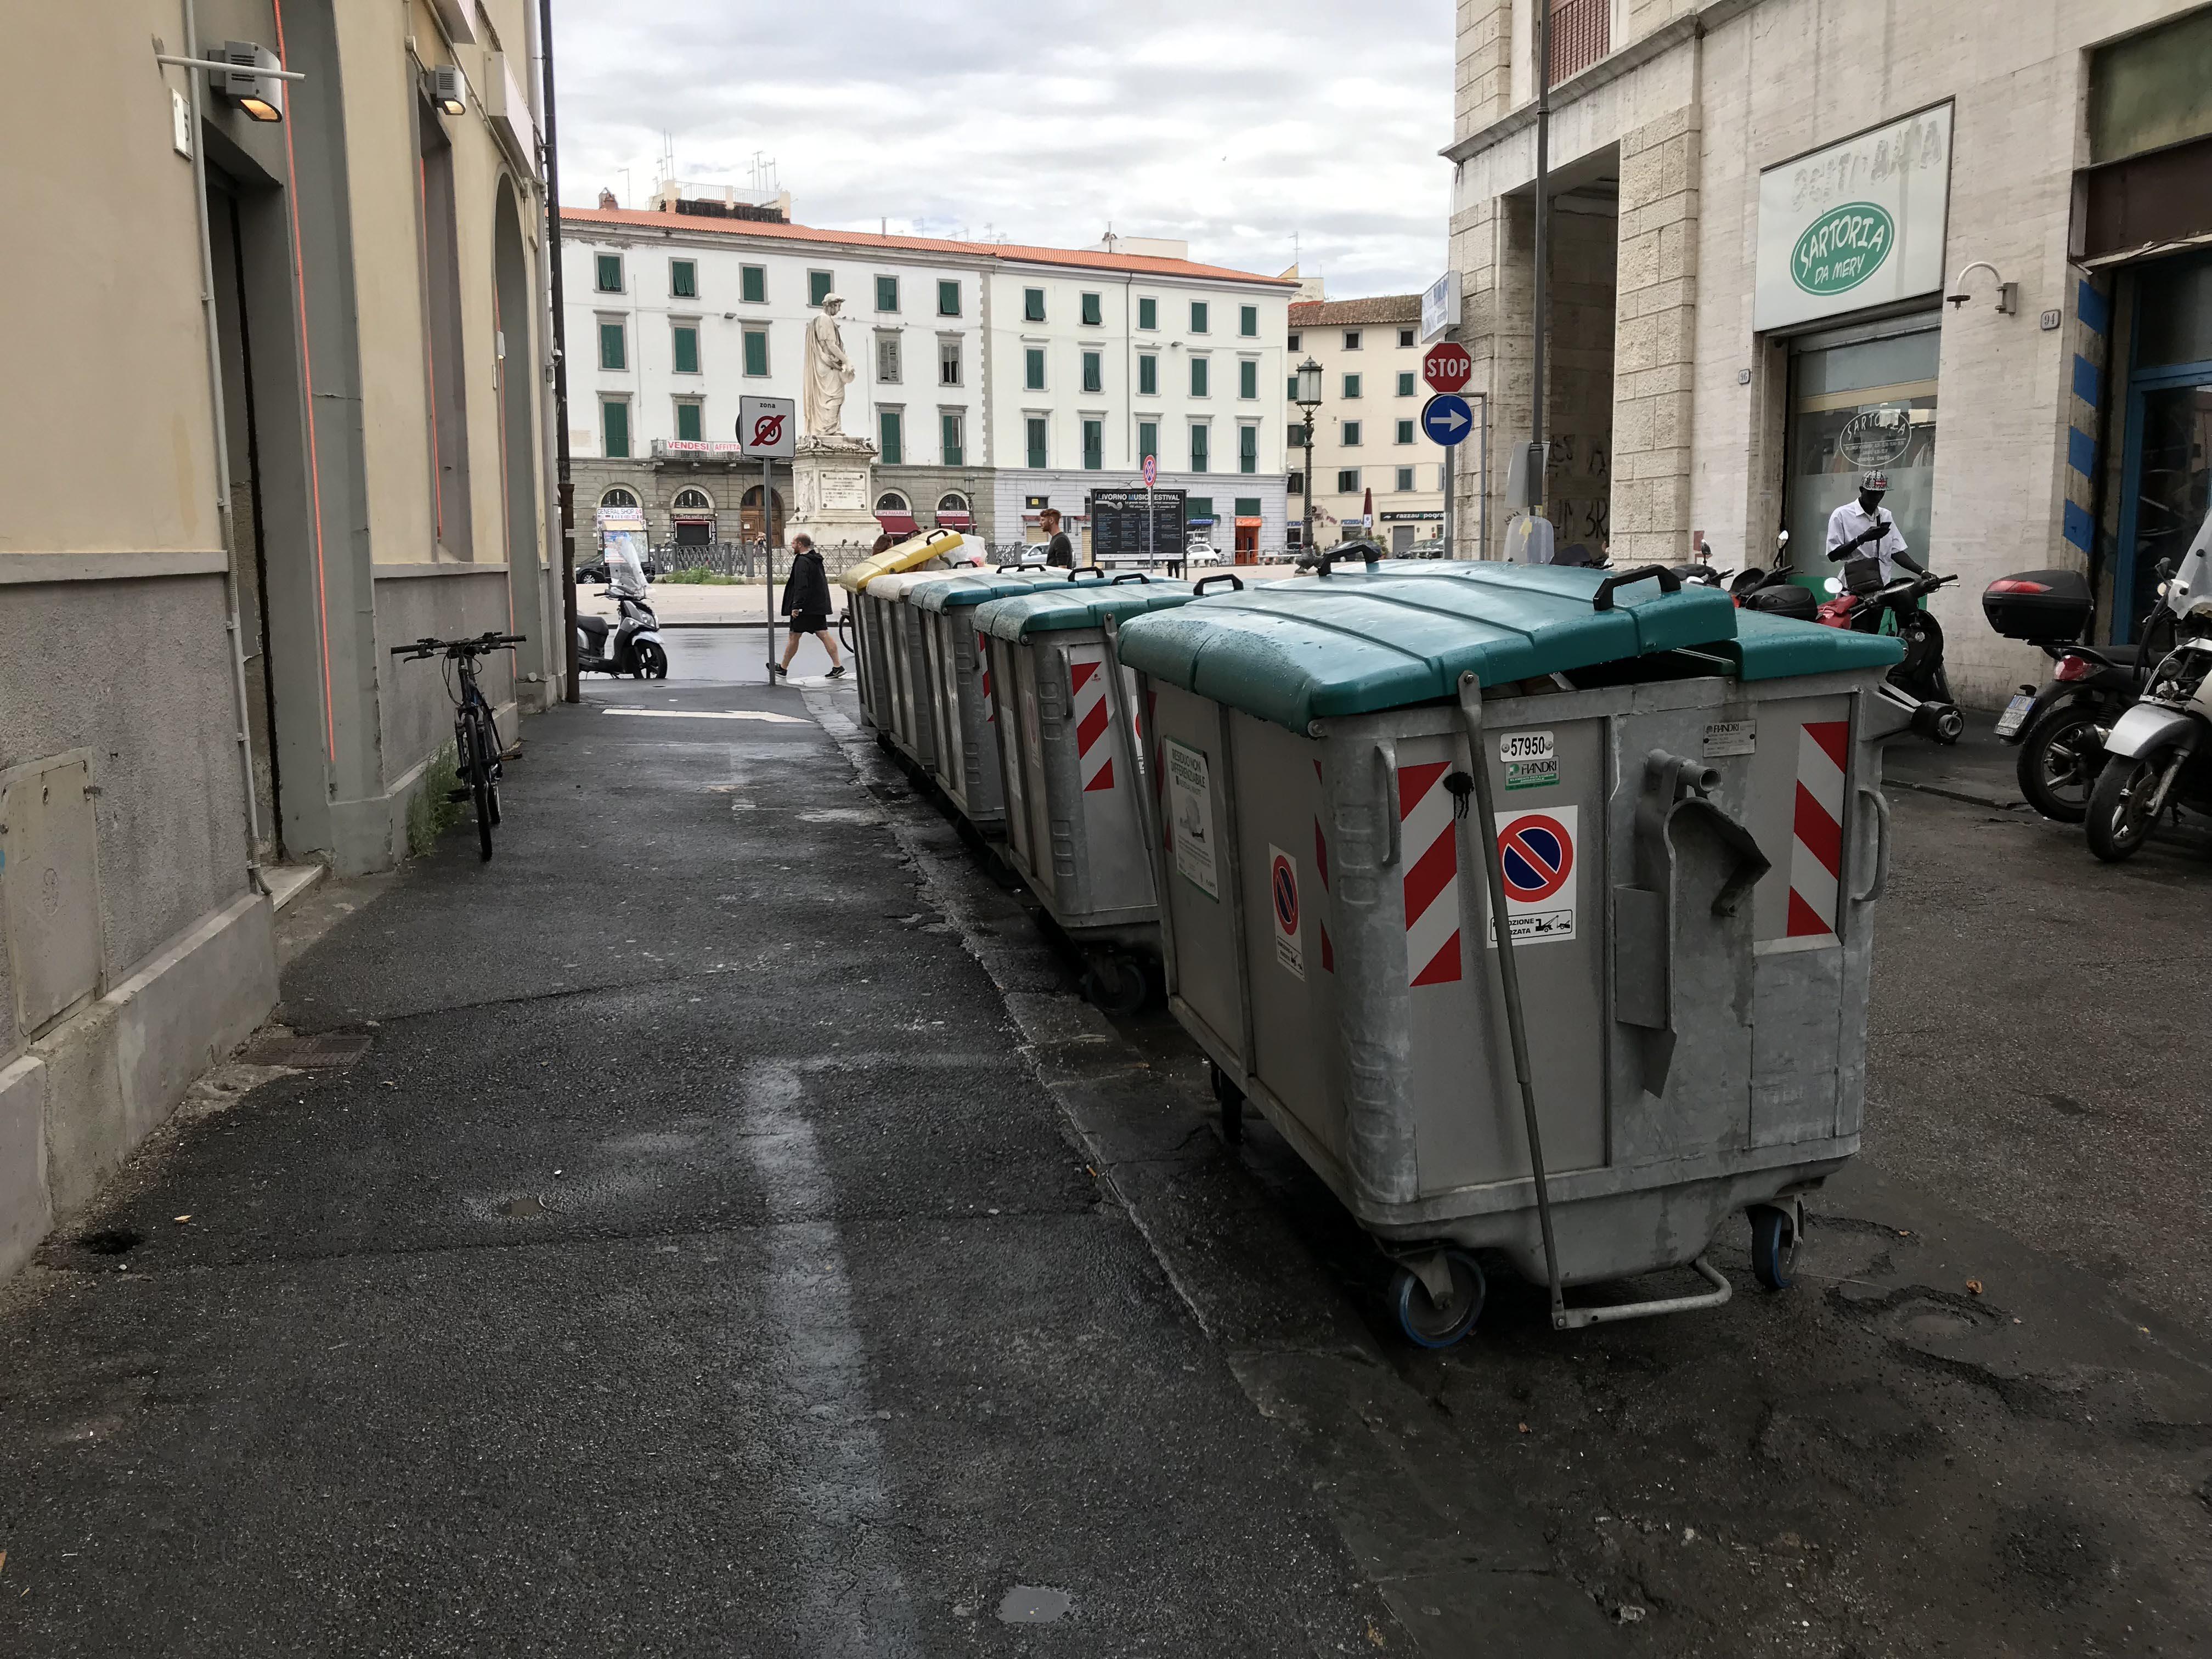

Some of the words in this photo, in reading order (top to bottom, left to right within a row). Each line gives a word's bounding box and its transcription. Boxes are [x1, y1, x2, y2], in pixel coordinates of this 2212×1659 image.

[1801, 215, 1885, 279] SARTORIA
[1815, 265, 1829, 285] DA
[1832, 253, 1865, 280] MERY
[2044, 313, 2055, 325] 94
[1427, 358, 1469, 377] STOP
[1740, 371, 1747, 381] 96
[668, 441, 709, 450] VENDESI
[1713, 723, 1740, 733] FIANDRI
[1511, 736, 1544, 756] 57950
[1522, 760, 1557, 775] FIANDRI
[1493, 918, 1534, 927] OZIONE
